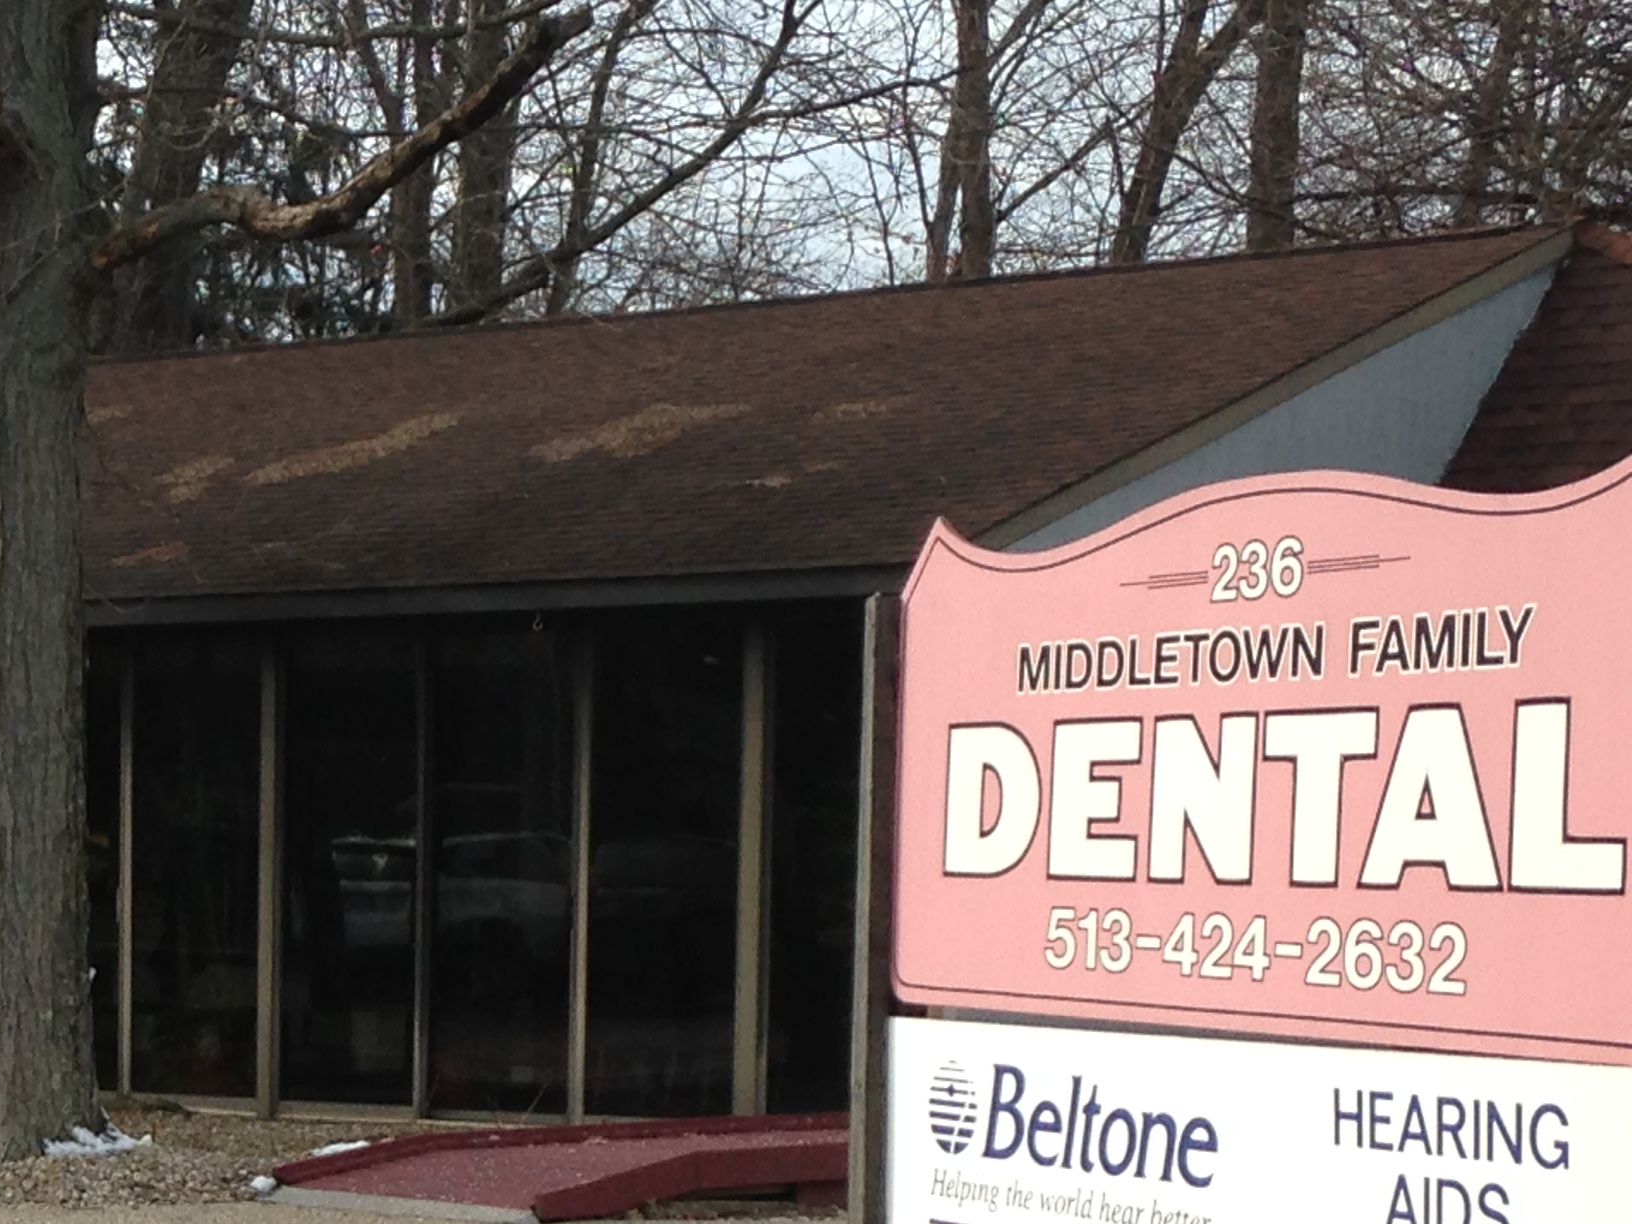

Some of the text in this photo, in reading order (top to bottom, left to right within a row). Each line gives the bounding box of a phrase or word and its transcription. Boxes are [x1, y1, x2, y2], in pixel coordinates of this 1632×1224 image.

[1210, 535, 1305, 604] 236
[1016, 603, 1537, 695] MIDDLETOWN FAMILY
[943, 696, 1628, 895] DENTAL
[1044, 906, 1467, 996] 513-424-2632
[980, 1063, 1219, 1188] Beltone
[1333, 1087, 1569, 1170] HEARING
[930, 1168, 999, 1213] Helping
[1005, 1179, 1034, 1212] the
[1039, 1188, 1093, 1220] world
